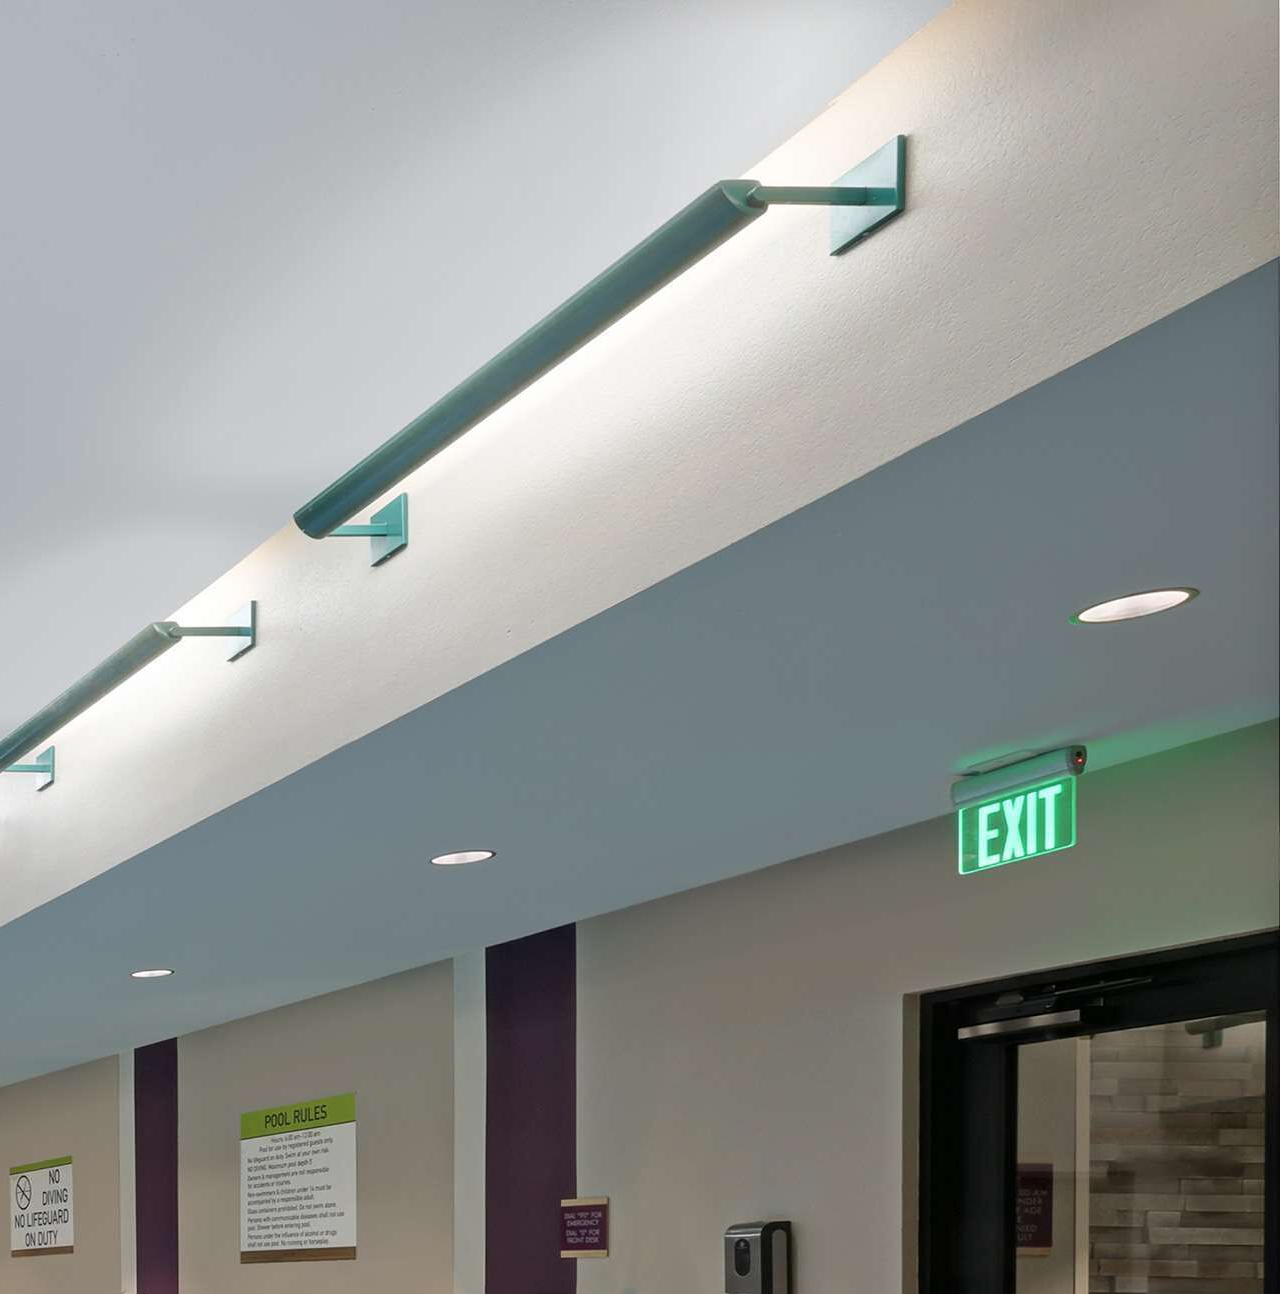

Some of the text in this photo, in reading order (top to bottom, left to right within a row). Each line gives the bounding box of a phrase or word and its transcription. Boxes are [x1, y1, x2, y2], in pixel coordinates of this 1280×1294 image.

[978, 783, 1062, 867] EXIT
[264, 1104, 328, 1128] POOL RULES
[48, 1169, 60, 1184] NO
[42, 1188, 68, 1206] DIVING
[14, 1208, 69, 1228] NO LIFEGUARD
[25, 1230, 58, 1247] ON DUTY
